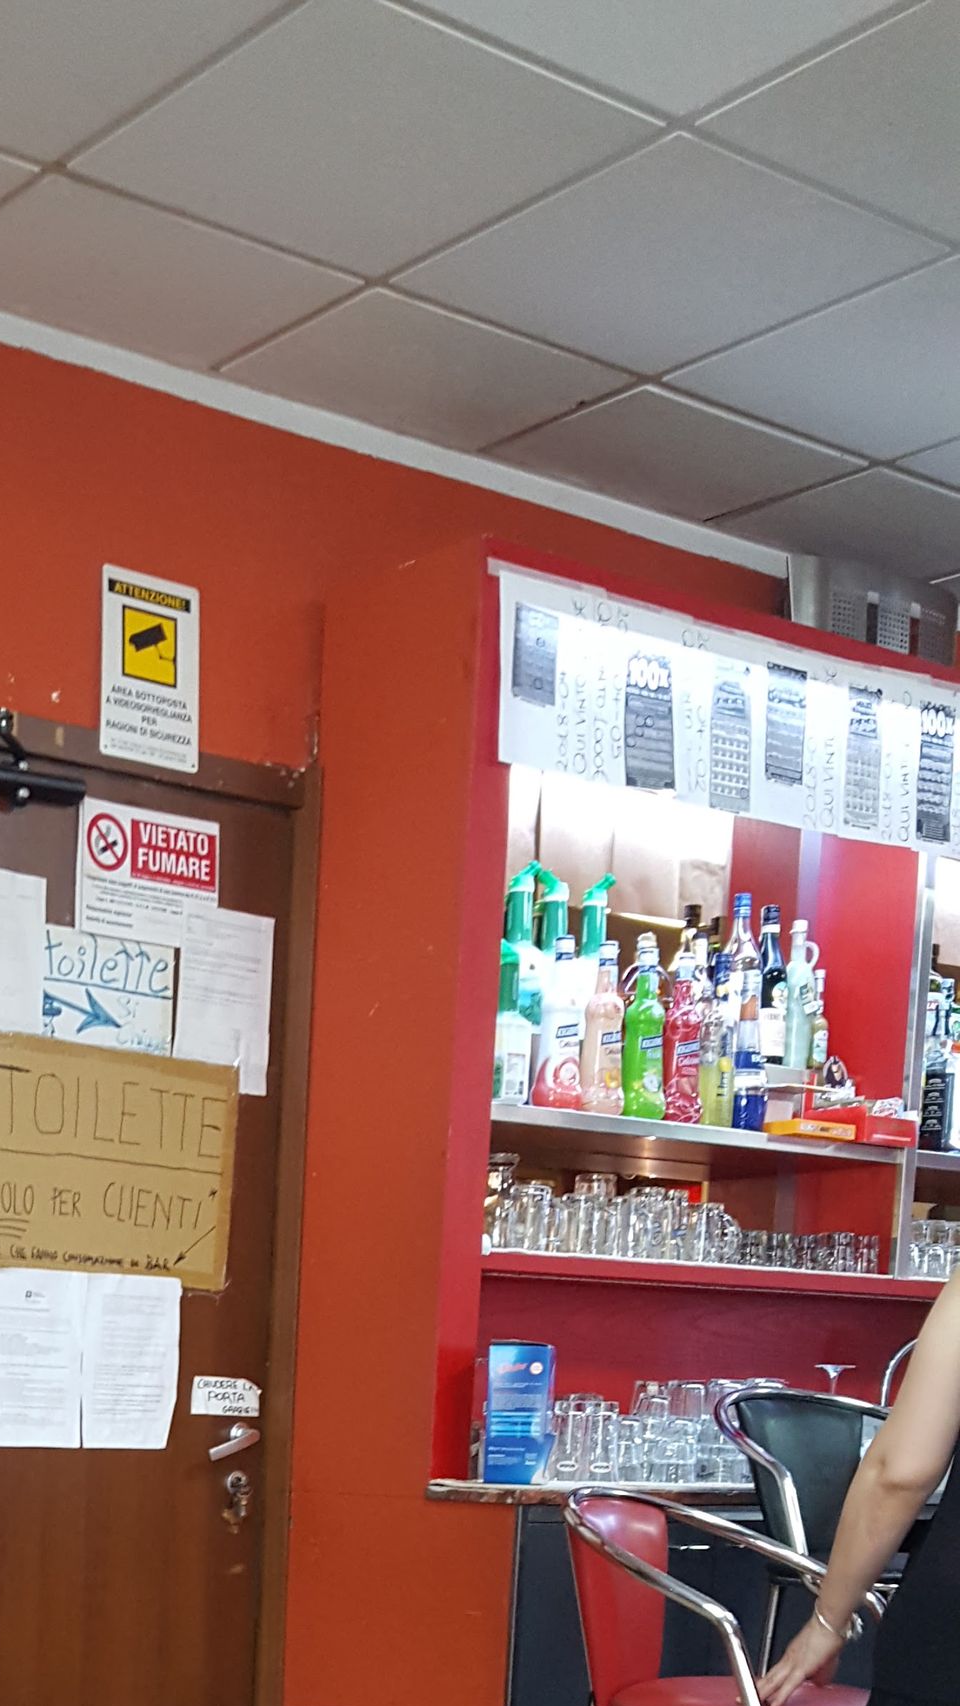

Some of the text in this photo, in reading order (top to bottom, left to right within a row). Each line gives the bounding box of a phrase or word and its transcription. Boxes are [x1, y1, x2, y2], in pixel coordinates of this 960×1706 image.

[113, 580, 187, 611] ATTENZIONE!
[111, 684, 188, 711] AREA SOTTOPOSTA
[113, 696, 193, 724] VIDEOSORVEGLIANZA
[105, 718, 193, 747] RAGIONI DI SICUREZZA
[141, 714, 158, 727] PER
[138, 821, 210, 857] VIETATO
[136, 847, 211, 882] FUMARE
[43, 928, 171, 995] toilette
[51, 1187, 82, 1218] PER
[103, 1182, 204, 1231] CLIENTI
[207, 1390, 246, 1404] PORTA
